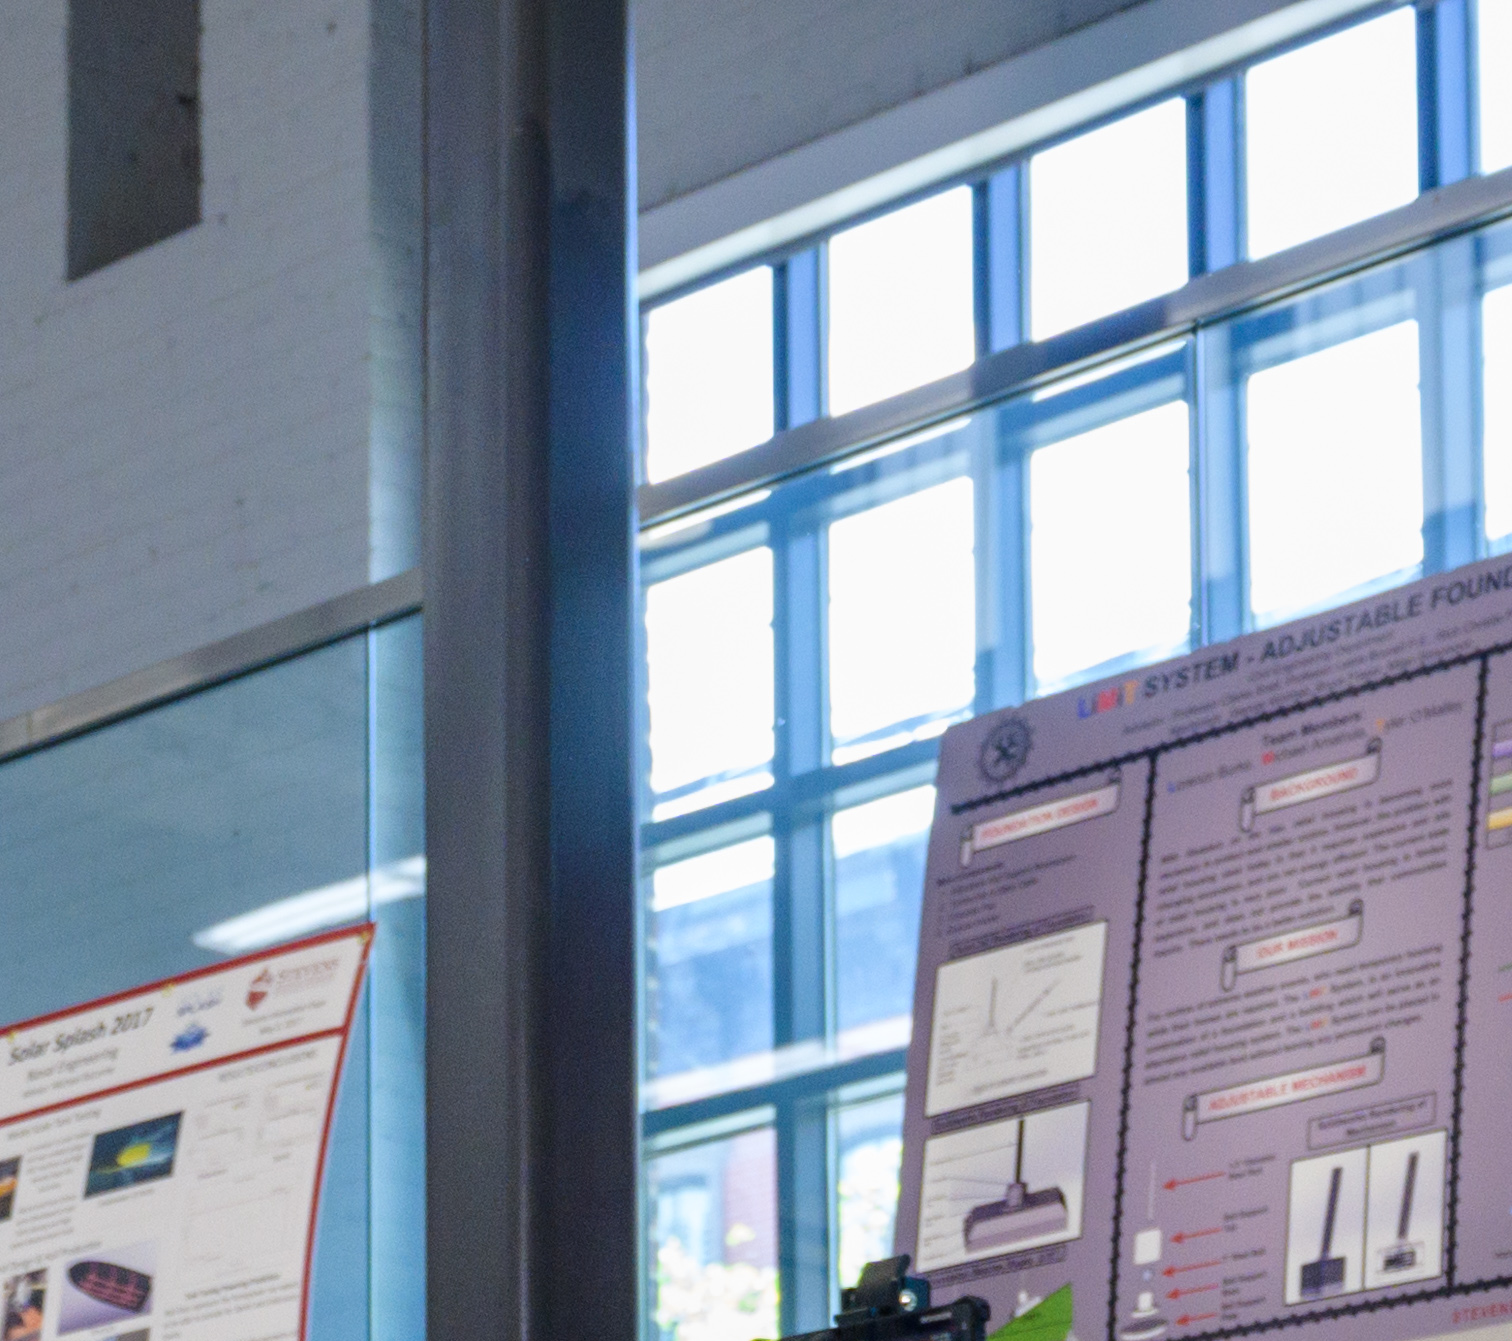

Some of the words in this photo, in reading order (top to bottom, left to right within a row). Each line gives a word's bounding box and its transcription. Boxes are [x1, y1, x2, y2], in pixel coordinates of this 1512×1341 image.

[1143, 652, 1239, 698] SYSTEM
[1261, 594, 1422, 664] ADJUSTABLE
[7, 1038, 53, 1067] Solar
[55, 1020, 107, 1054] Splash
[110, 1005, 155, 1036] 2017
